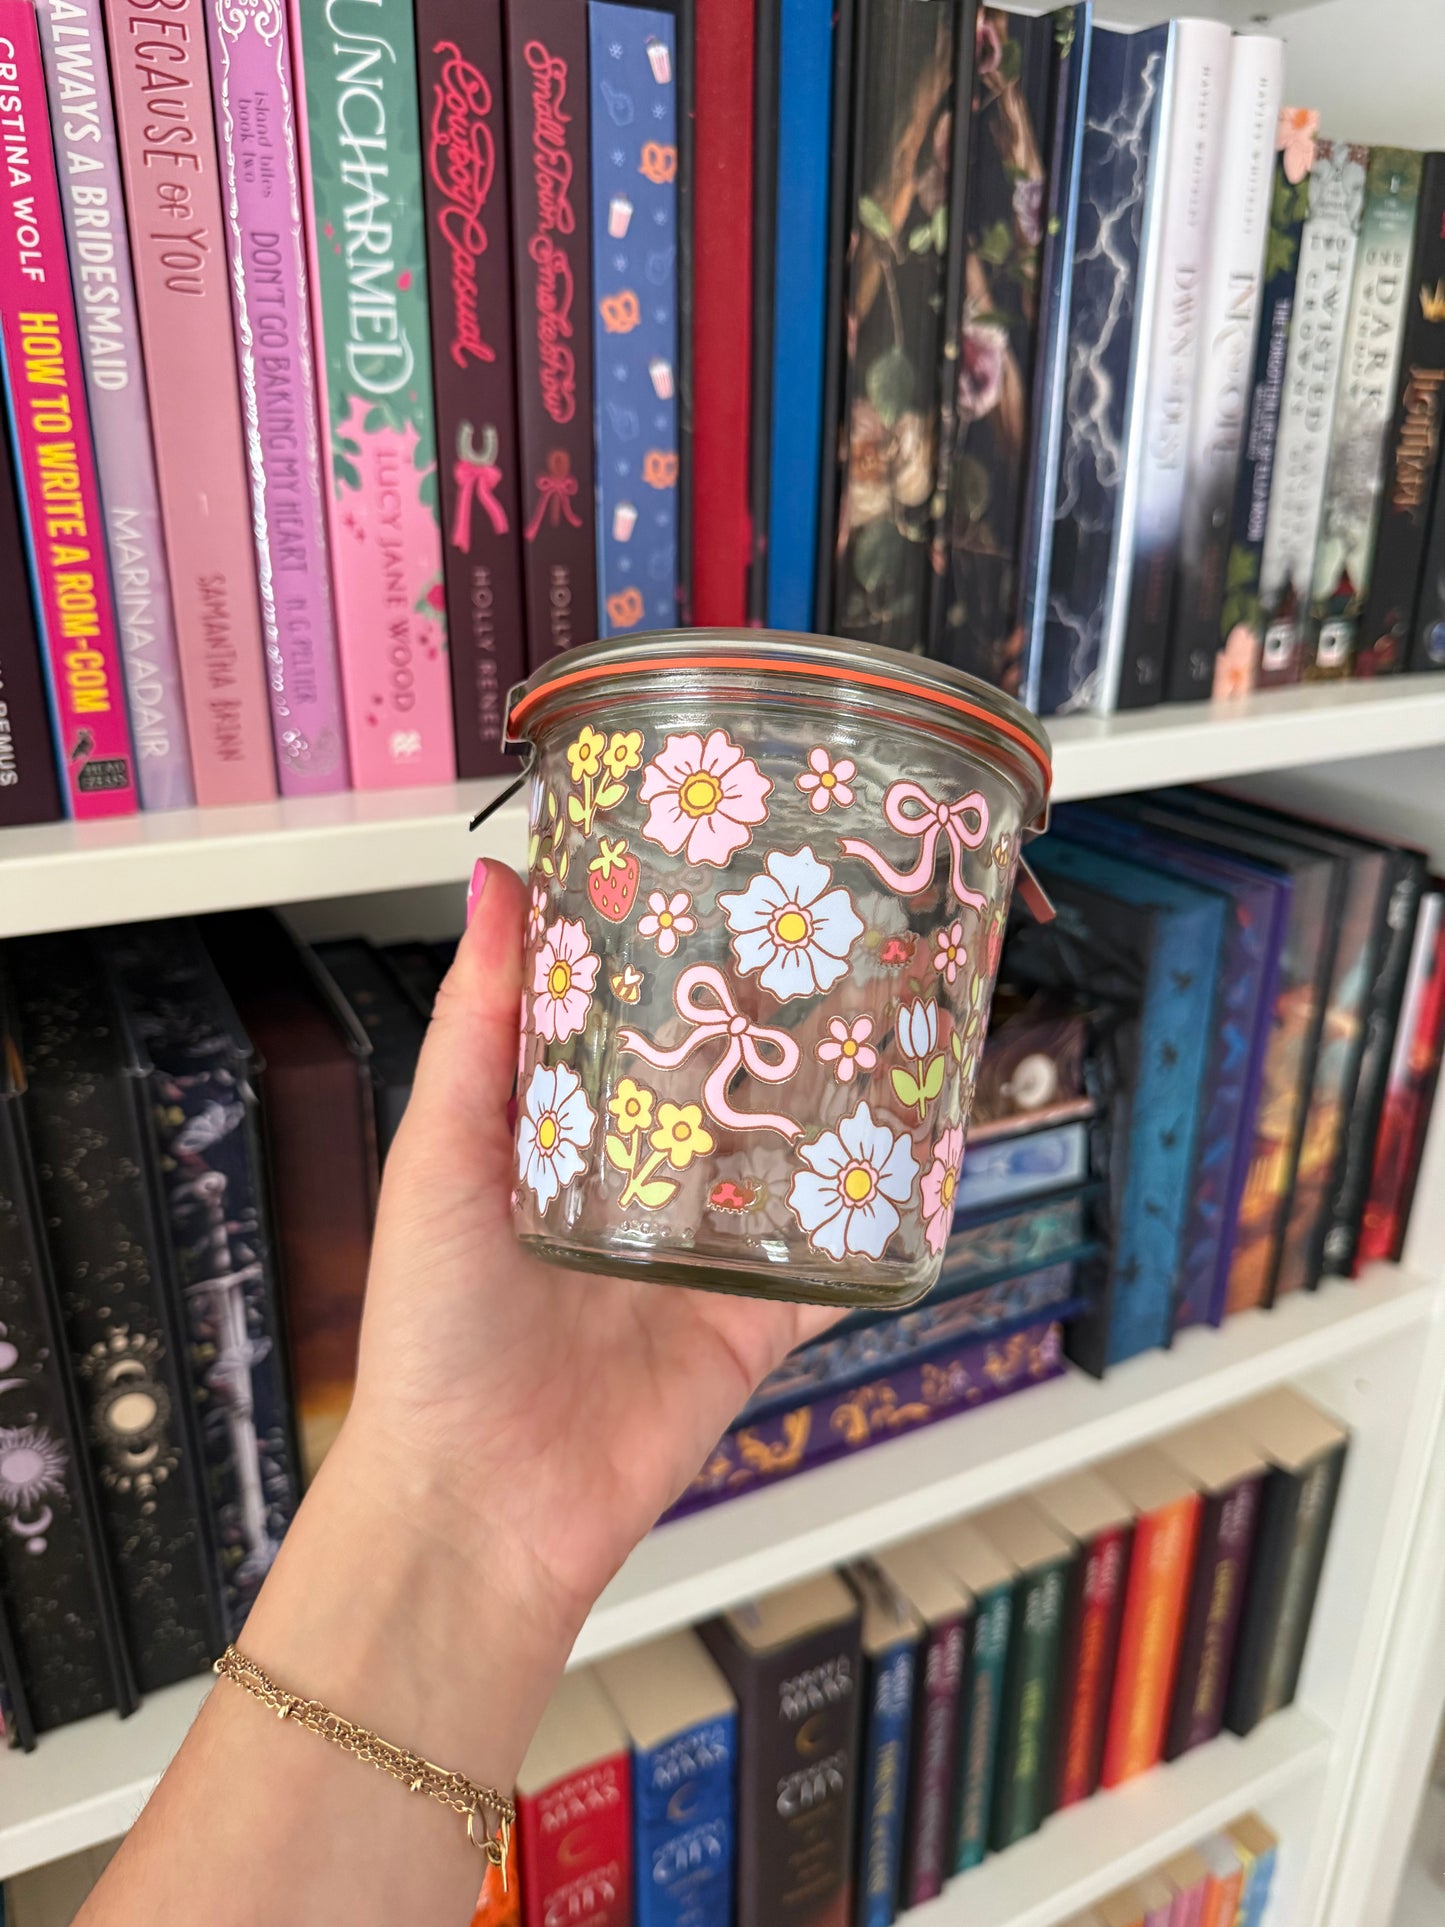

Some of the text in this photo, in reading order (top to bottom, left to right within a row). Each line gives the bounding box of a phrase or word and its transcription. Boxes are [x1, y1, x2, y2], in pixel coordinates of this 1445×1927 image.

[126, 0, 203, 173] BECAUSE
[238, 98, 255, 143] book
[254, 91, 271, 148] island
[523, 40, 572, 150] Small
[0, 37, 45, 282] CRISTINA WOLF
[50, 0, 128, 391] ALWAYS A BRIDESMAID
[326, 0, 413, 393] UNCHARMED
[430, 41, 495, 367] Cowboy Casual
[533, 149, 575, 234] Town
[150, 227, 209, 298] YOU
[19, 312, 67, 386] HOW
[250, 232, 308, 574] DON'T GO BAKING MY HEART
[30, 395, 73, 433] TO
[37, 443, 91, 538] WRITE
[52, 543, 91, 566] A
[375, 449, 414, 713] LUCY JANE WOOD
[53, 572, 111, 714] ROM-COM
[111, 505, 170, 759] MARINA ADAIR
[196, 572, 238, 689] SAMANTHA
